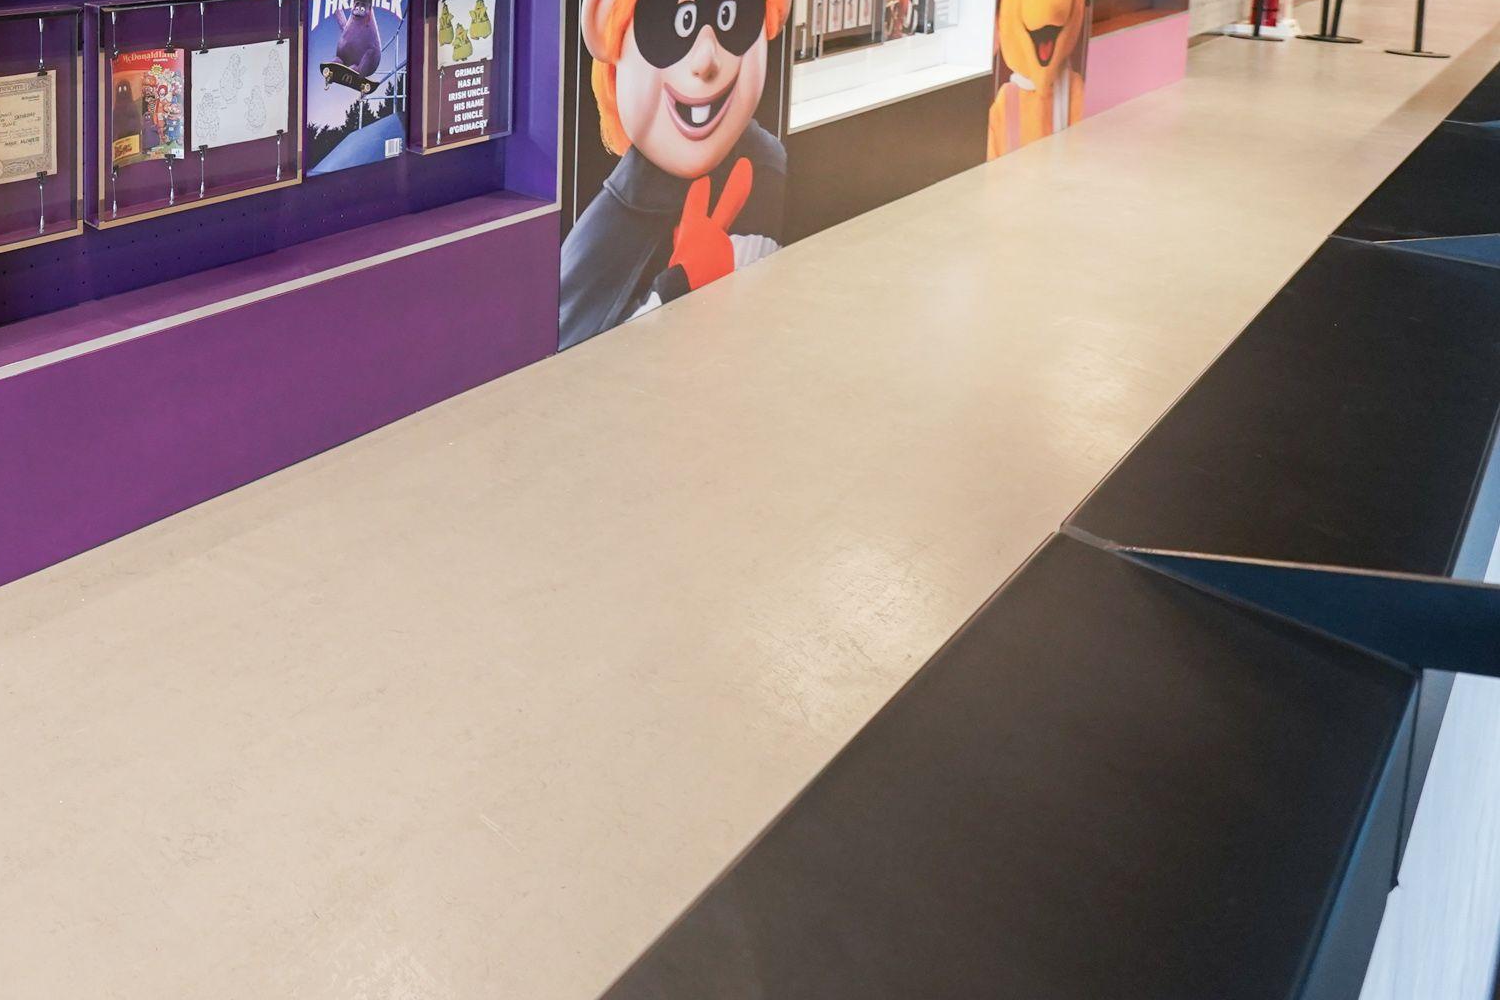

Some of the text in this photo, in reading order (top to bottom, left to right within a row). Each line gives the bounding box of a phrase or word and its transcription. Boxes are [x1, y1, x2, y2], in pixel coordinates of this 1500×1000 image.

[455, 65, 484, 78] GRIMACE
[458, 77, 481, 89] HAS AN
[448, 86, 490, 101] IRISH UNCLE.
[453, 98, 484, 111] HIS NAME
[455, 109, 483, 122] IS UNCLE
